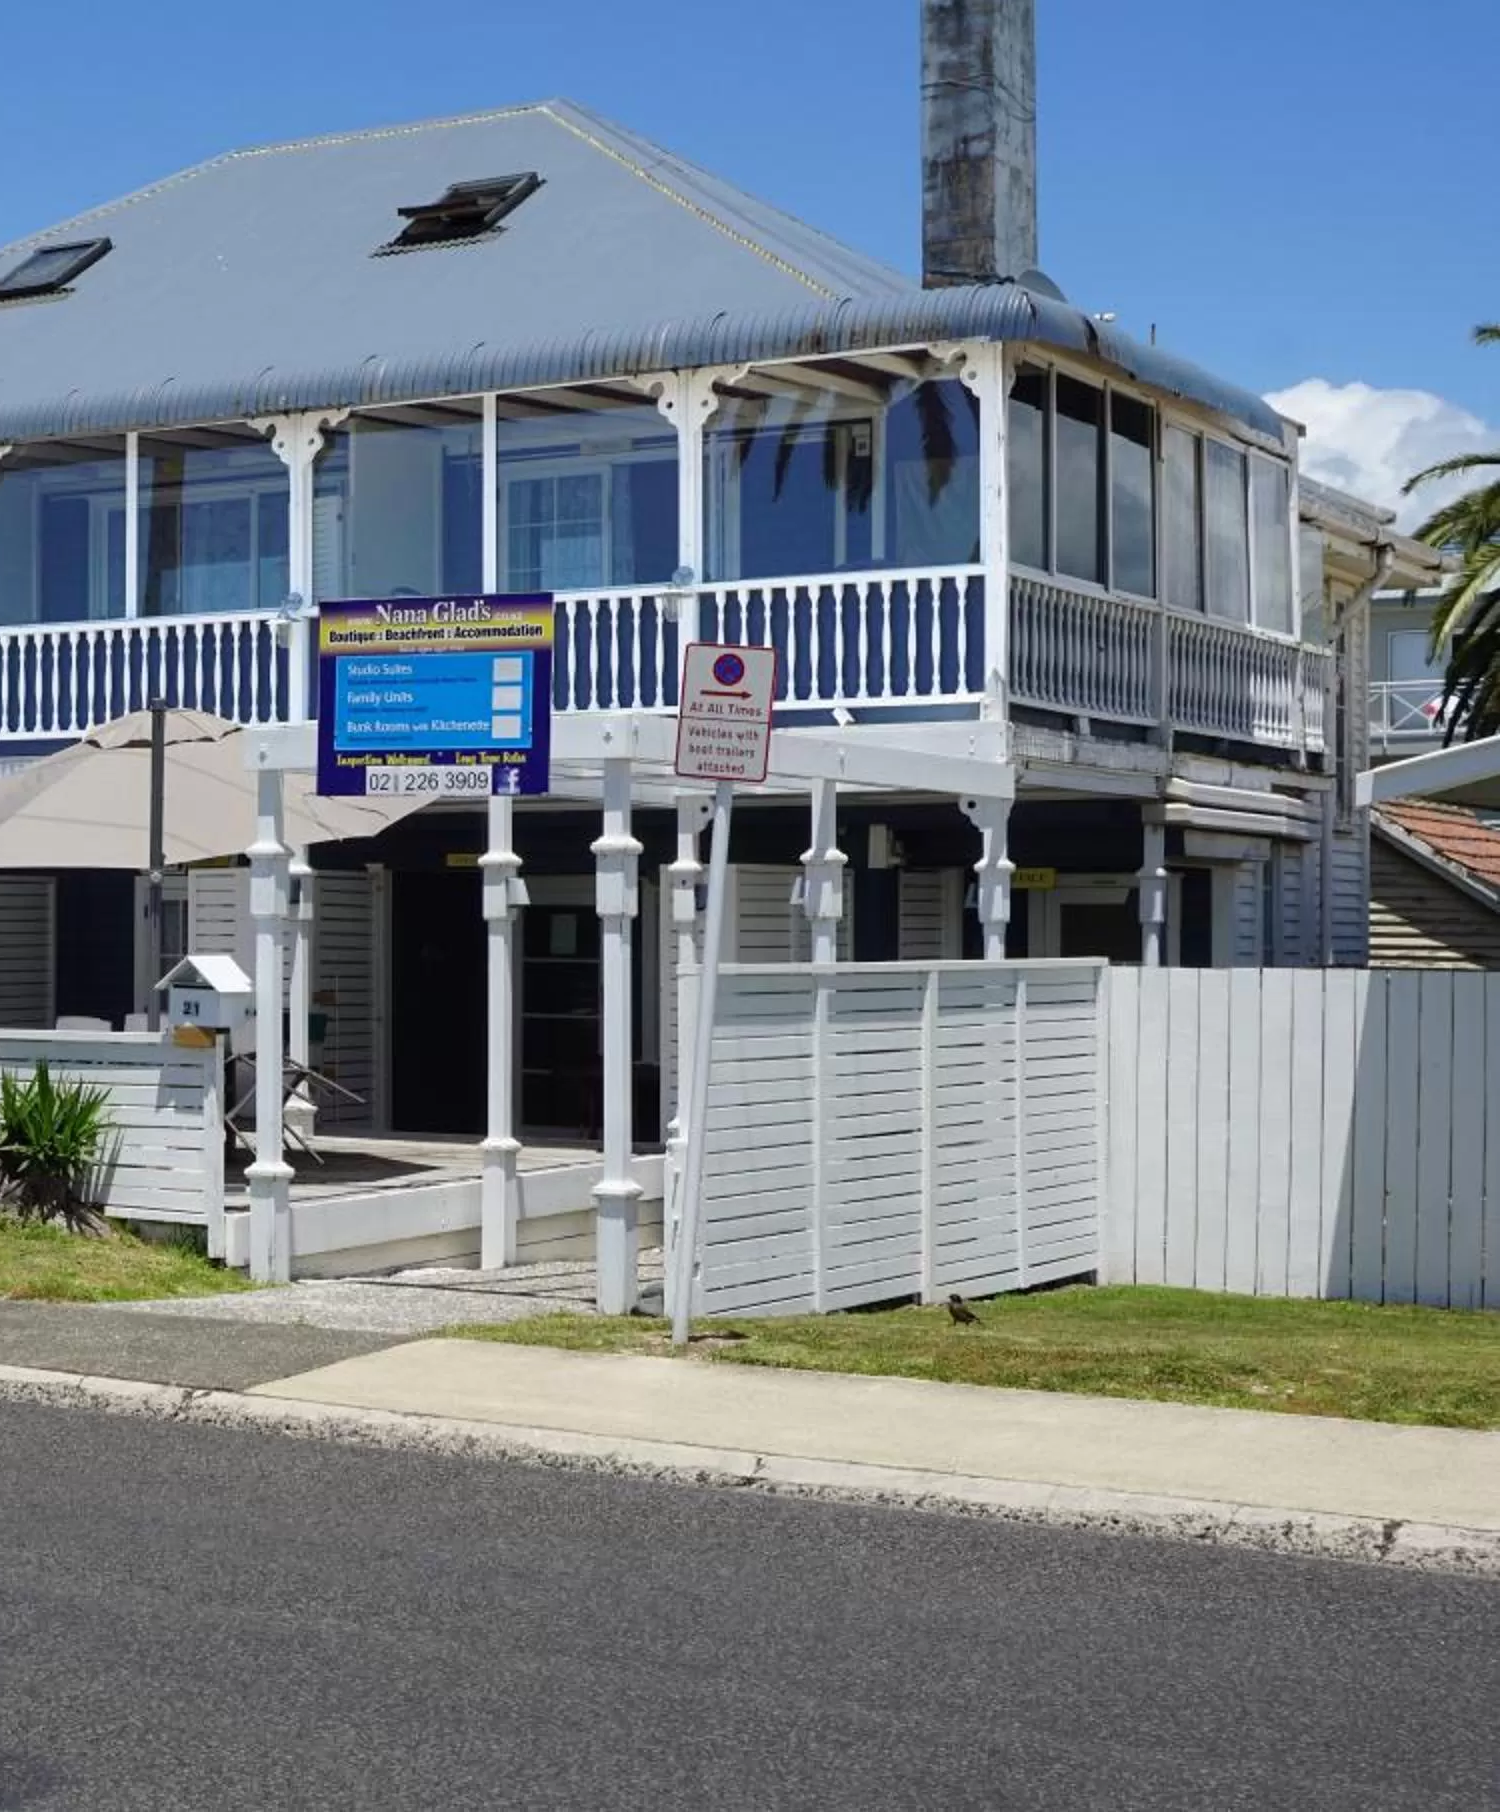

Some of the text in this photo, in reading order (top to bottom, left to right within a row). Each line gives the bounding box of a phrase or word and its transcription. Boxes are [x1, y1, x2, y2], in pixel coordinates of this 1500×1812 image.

[375, 604, 427, 625] Nana
[432, 599, 492, 622] Glad's
[329, 629, 376, 644] Boutique
[385, 625, 445, 641] Beachfront
[453, 623, 543, 639] Accommodation
[347, 663, 413, 676] Studio Suites
[347, 691, 414, 707] Family Units
[689, 703, 763, 716] At All Times
[347, 720, 373, 733] Bunk
[375, 719, 410, 733] Rooms
[687, 727, 760, 742] Vehicles with
[688, 744, 756, 758] boat trailers
[696, 761, 745, 774] attached
[405, 773, 439, 791] 226
[444, 771, 489, 790] 3909
[182, 1000, 200, 1016] 21
